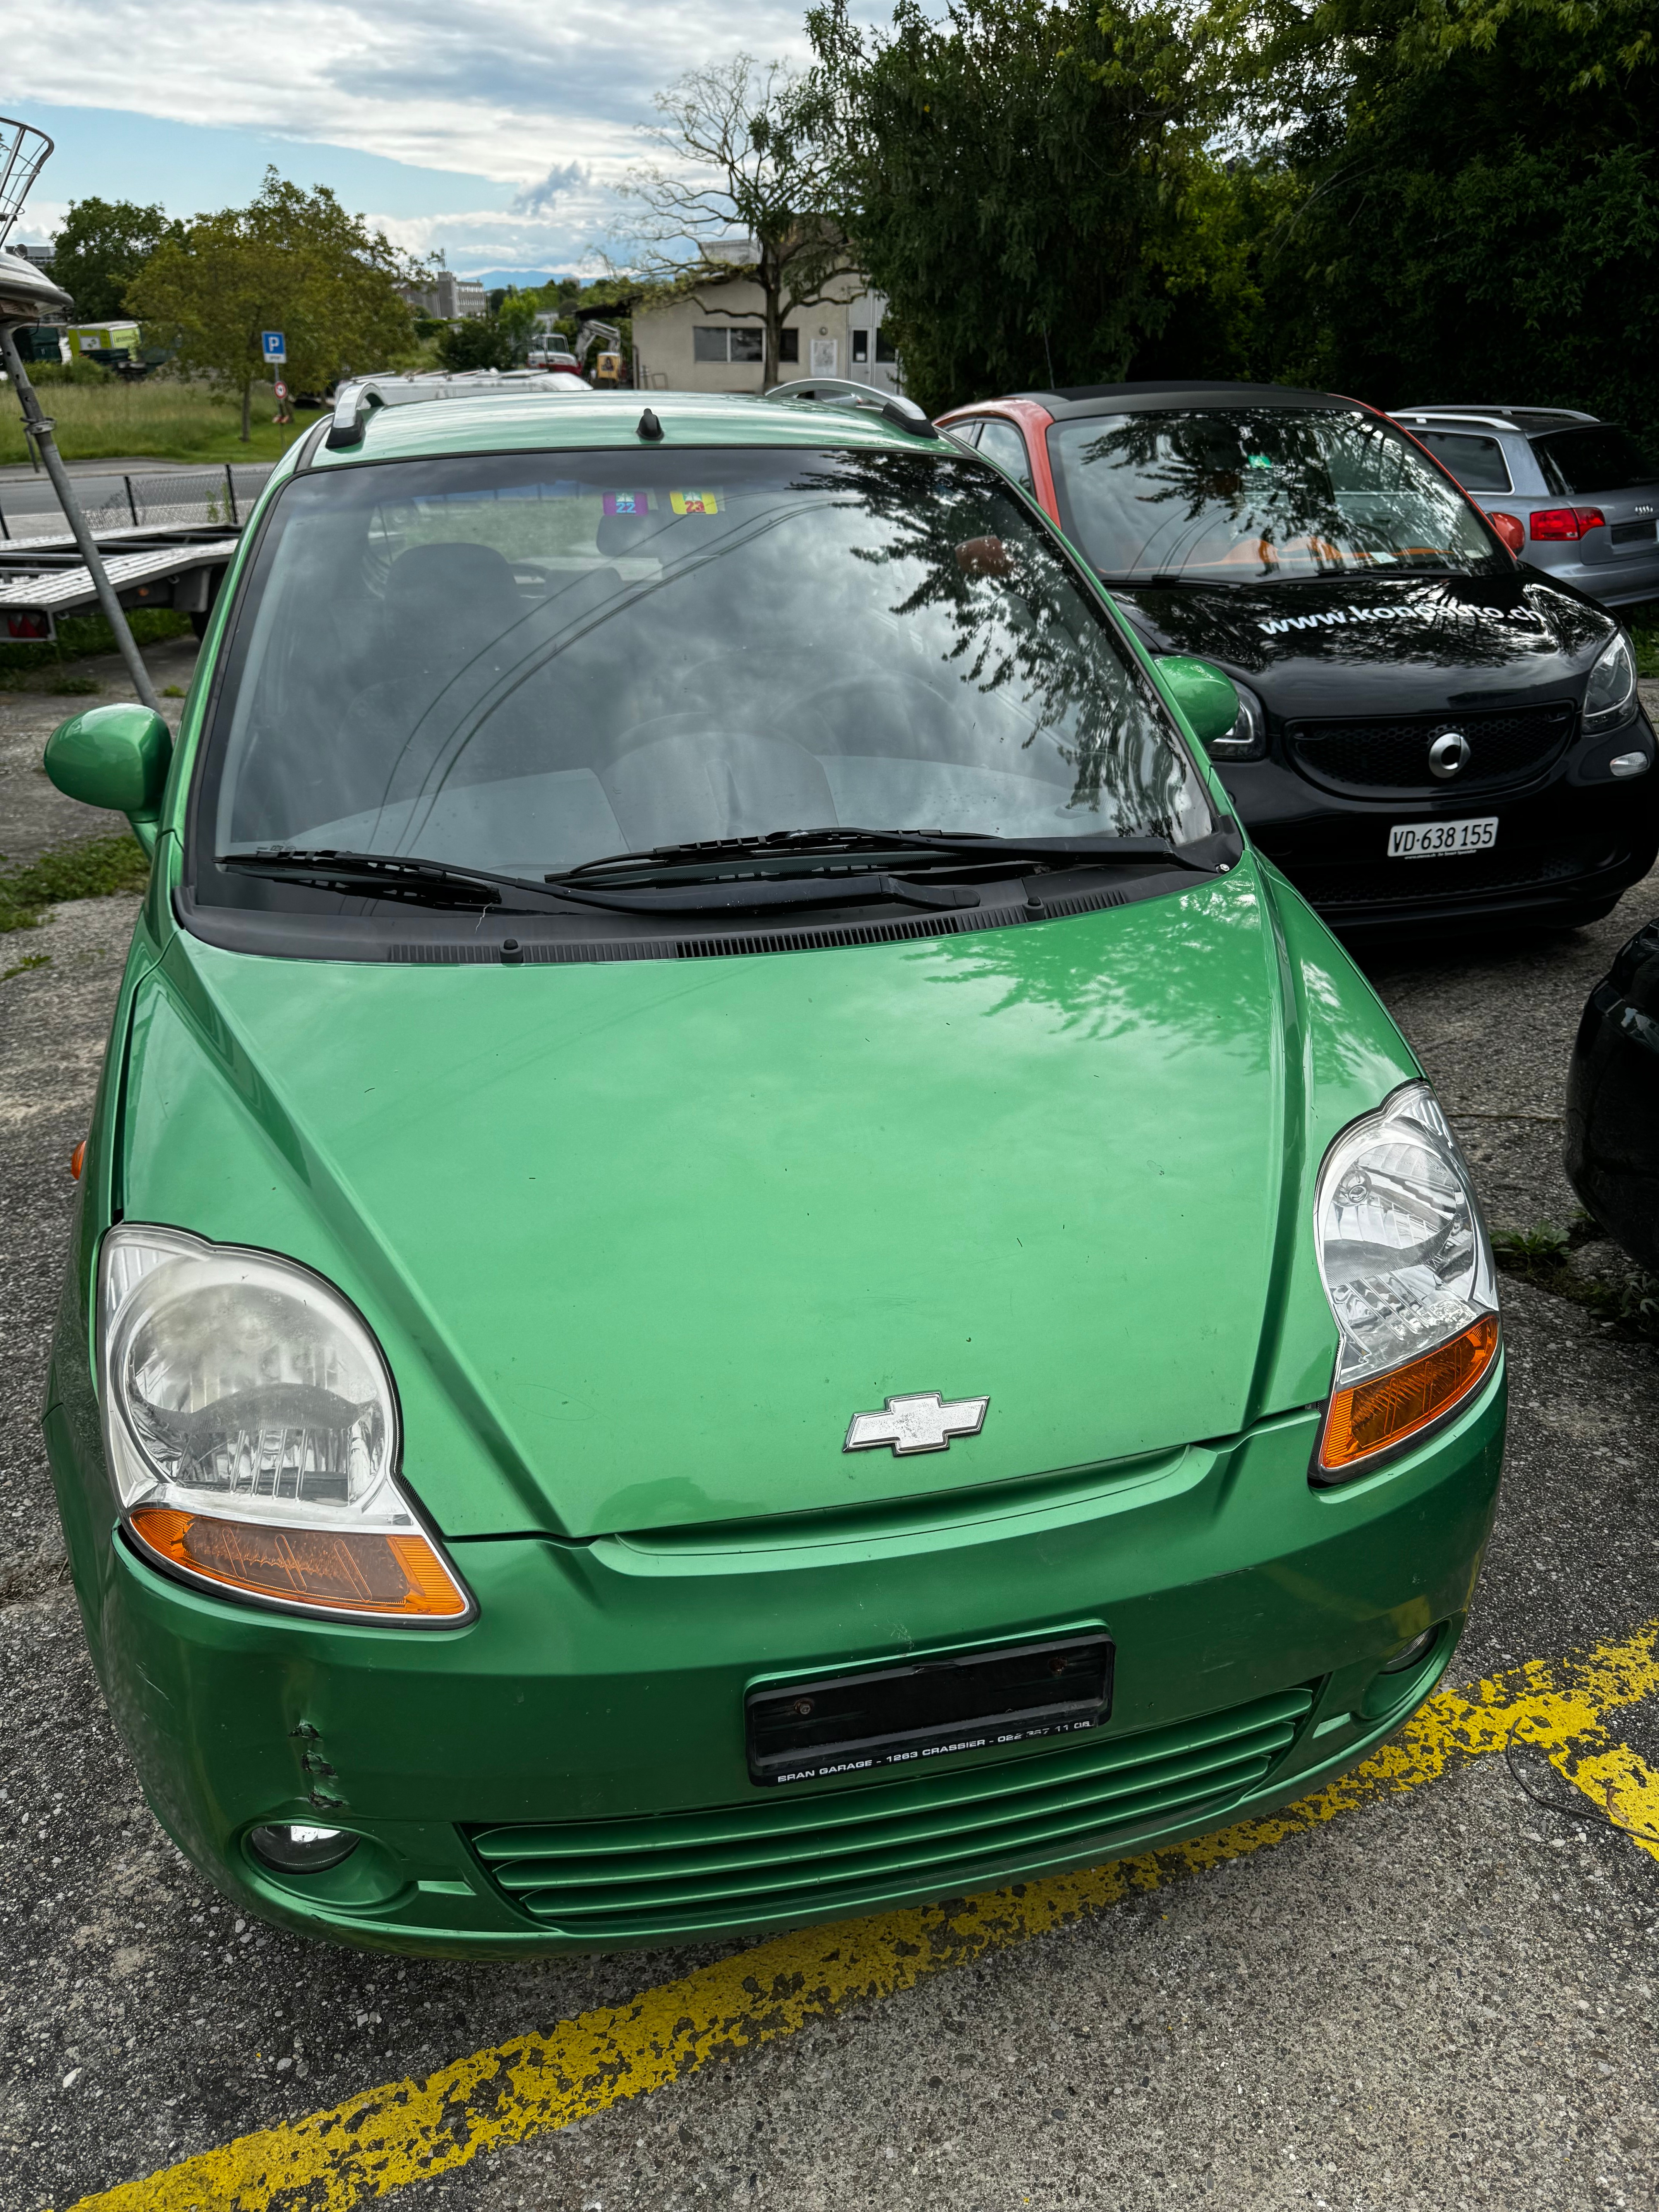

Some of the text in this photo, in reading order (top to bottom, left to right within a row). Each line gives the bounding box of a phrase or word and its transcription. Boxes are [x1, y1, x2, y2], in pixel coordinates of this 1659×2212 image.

[268, 337, 280, 352] P
[616, 502, 636, 513] 22
[684, 501, 705, 513] 23
[1258, 605, 1547, 634] www.konoauto.ch
[1460, 823, 1494, 847] 155
[778, 1770, 815, 1783] BRAN
[819, 1760, 872, 1775] GARAGE
[886, 1751, 918, 1762] 1263
[922, 1739, 985, 1756] CRASSIER
[1054, 1724, 1069, 1732] 11
